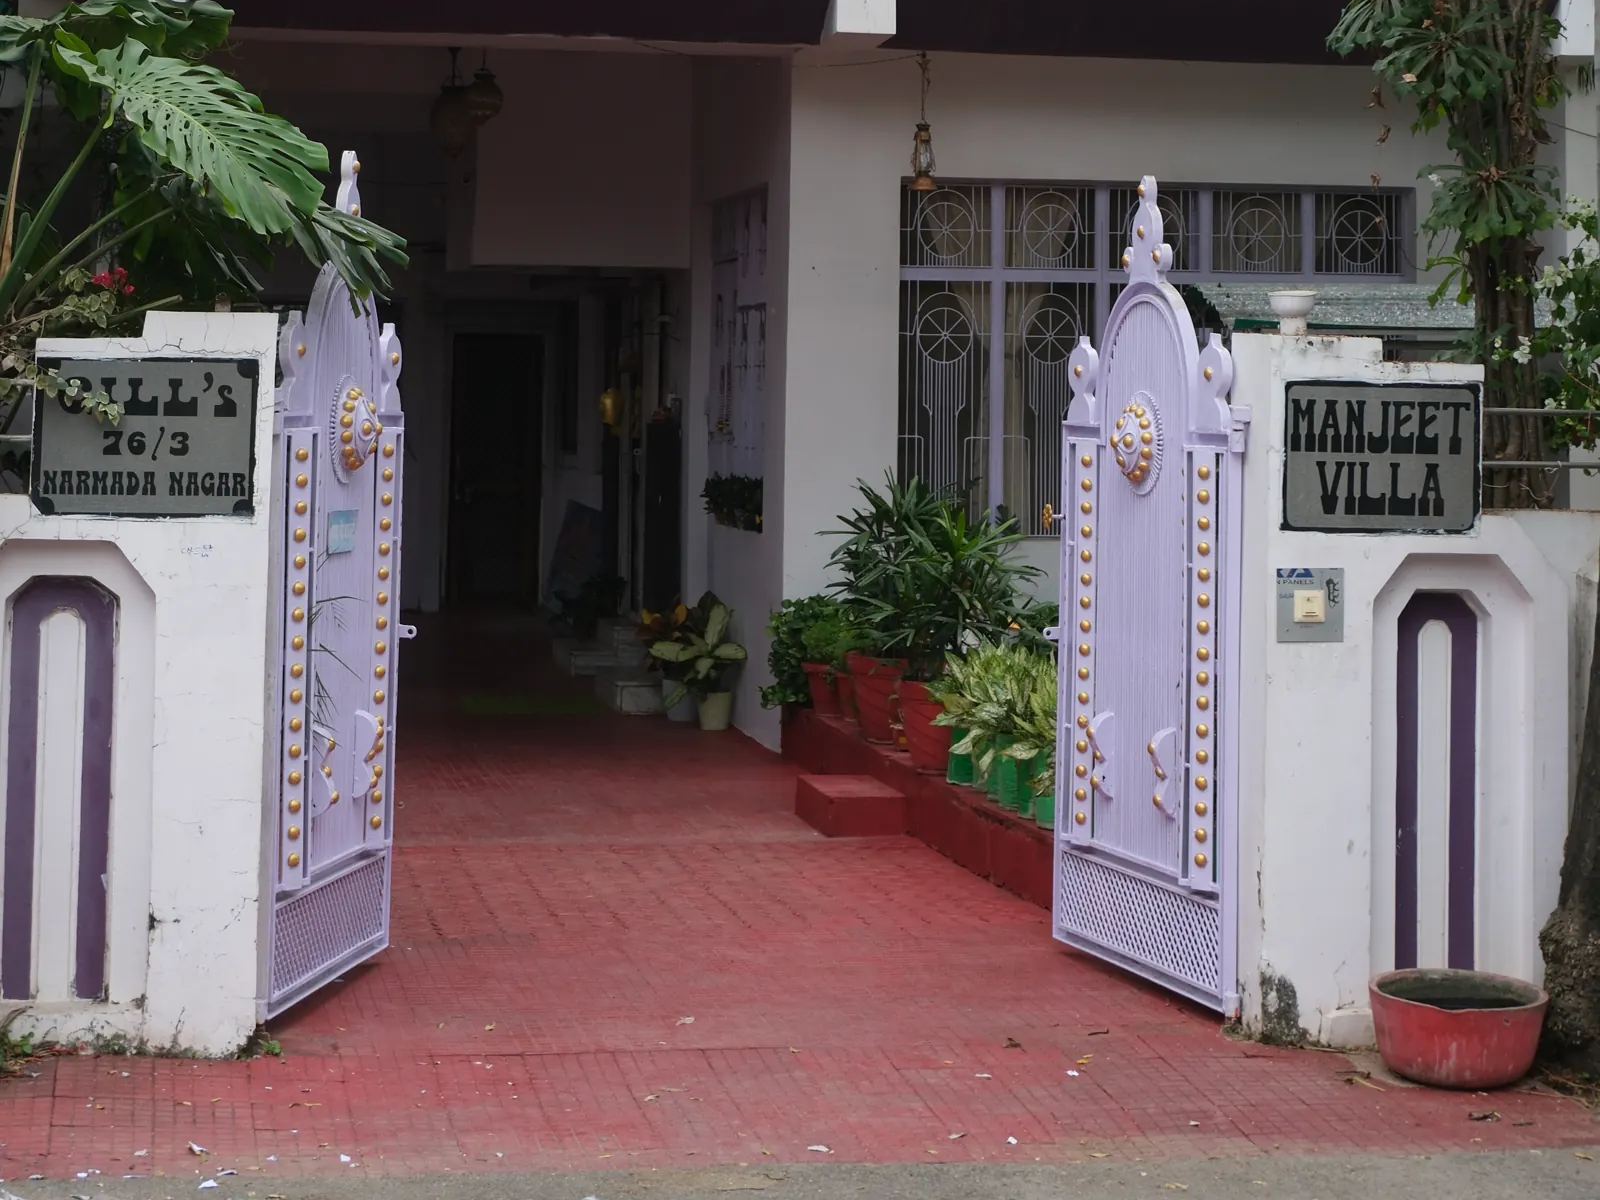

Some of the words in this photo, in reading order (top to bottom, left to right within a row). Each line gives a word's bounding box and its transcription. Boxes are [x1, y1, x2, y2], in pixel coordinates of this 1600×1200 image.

[102, 426, 190, 461] 76/3
[1290, 398, 1470, 455] MANJEET
[43, 470, 157, 496] NARMADA
[169, 471, 247, 497] NAGAR
[1316, 460, 1445, 517] VILLA
